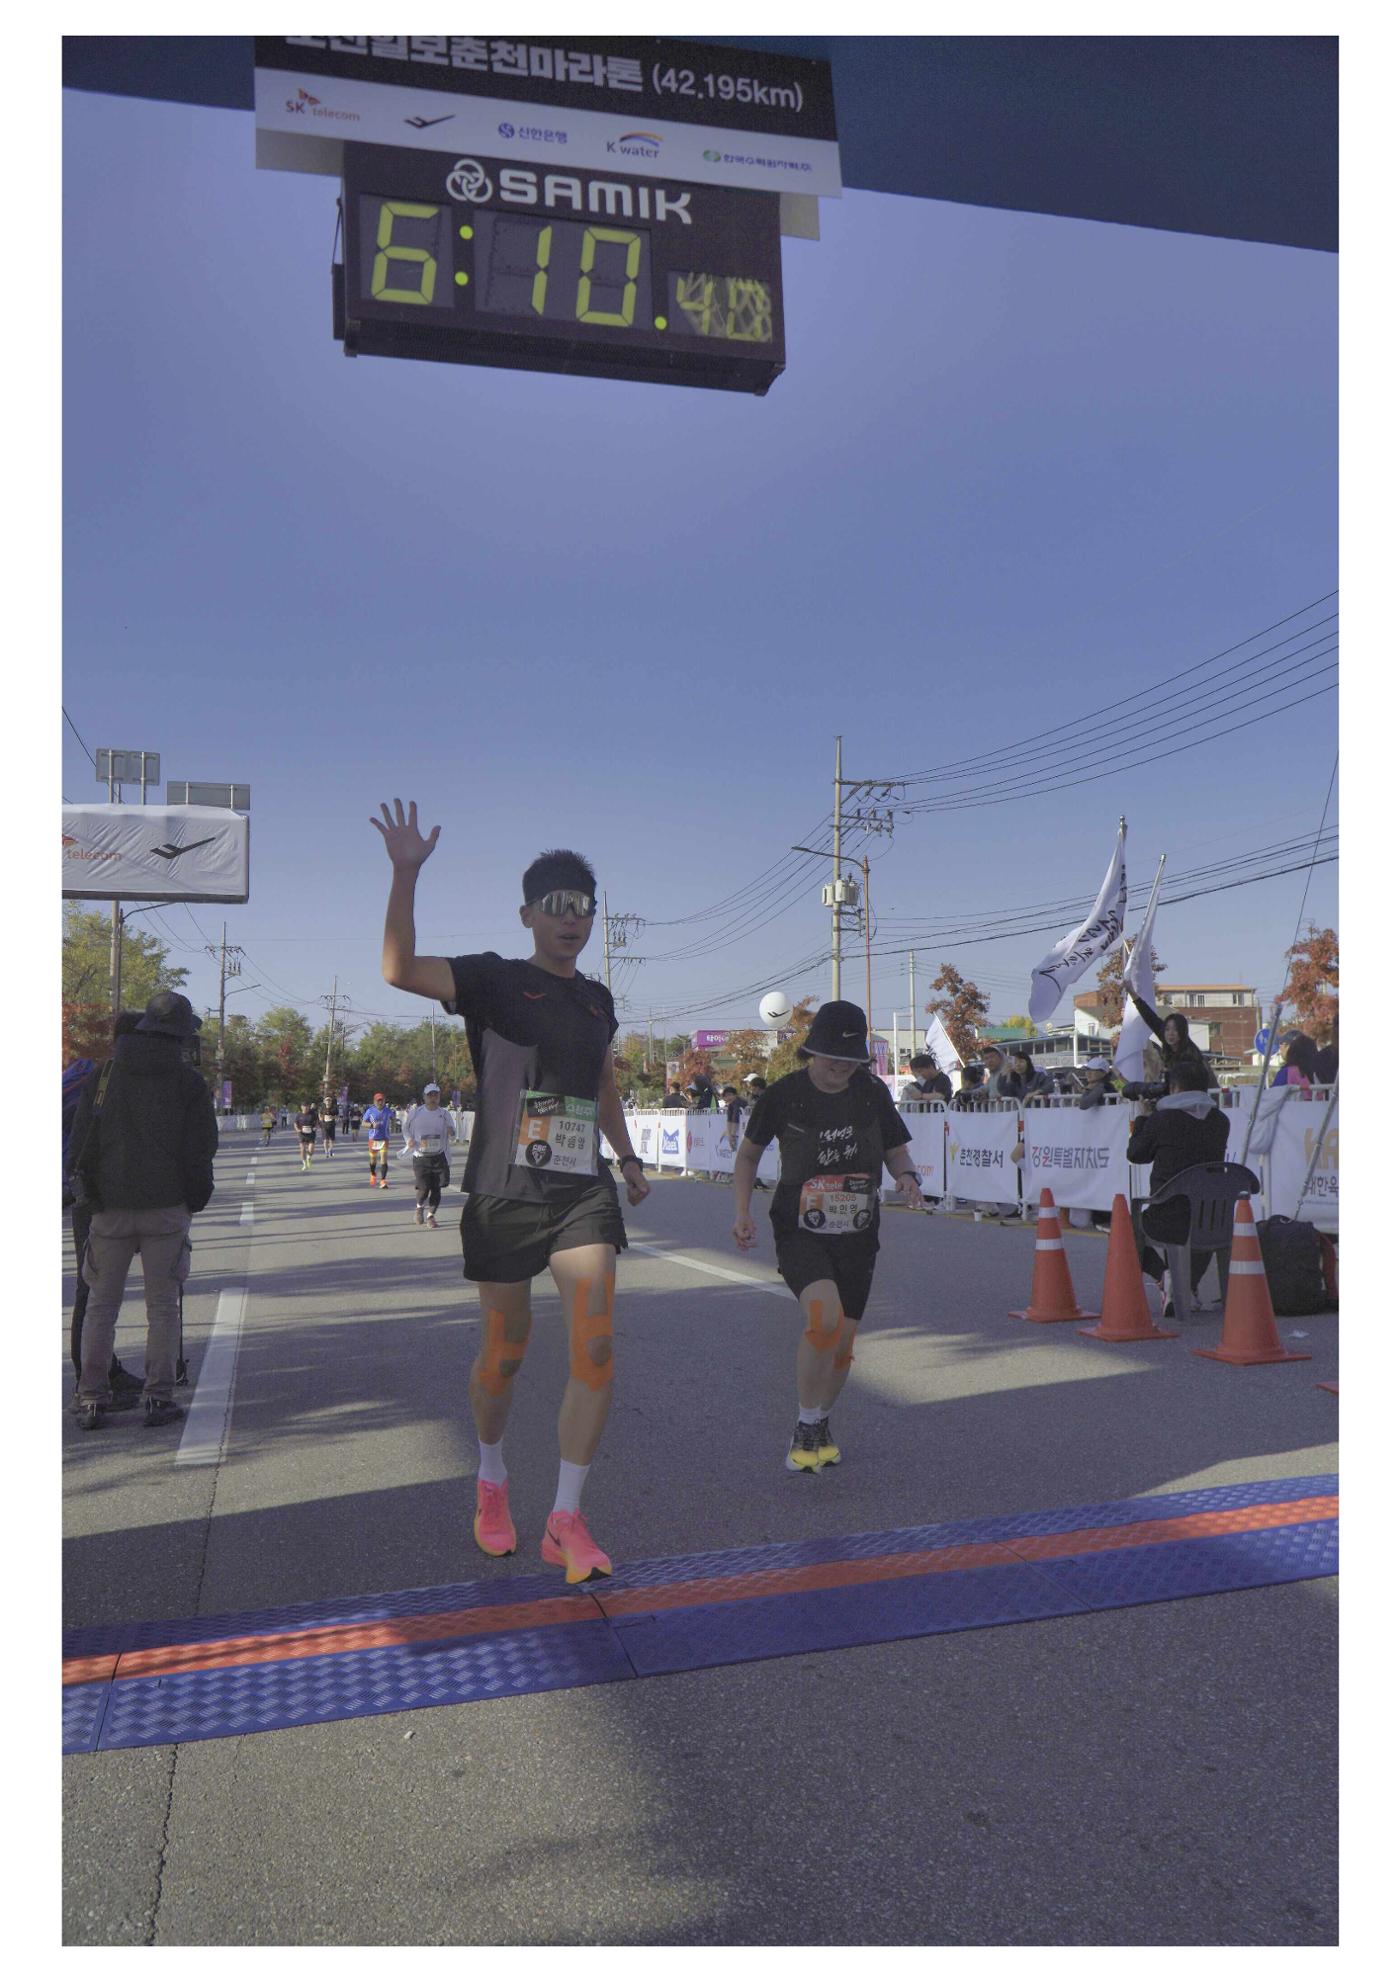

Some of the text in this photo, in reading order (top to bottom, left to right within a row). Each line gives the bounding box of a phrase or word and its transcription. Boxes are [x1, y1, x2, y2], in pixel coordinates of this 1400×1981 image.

[651, 62, 804, 113] (42.195km)
[285, 100, 360, 122] SK telecom
[518, 125, 568, 144] 신한은행
[606, 142, 660, 159] K water
[499, 168, 694, 227] SAMIK
[67, 847, 122, 861] telecom
[528, 1119, 543, 1140] E
[959, 1148, 1004, 1168] 춘천경찰서
[1032, 1146, 1110, 1169] 강원특별자치도
